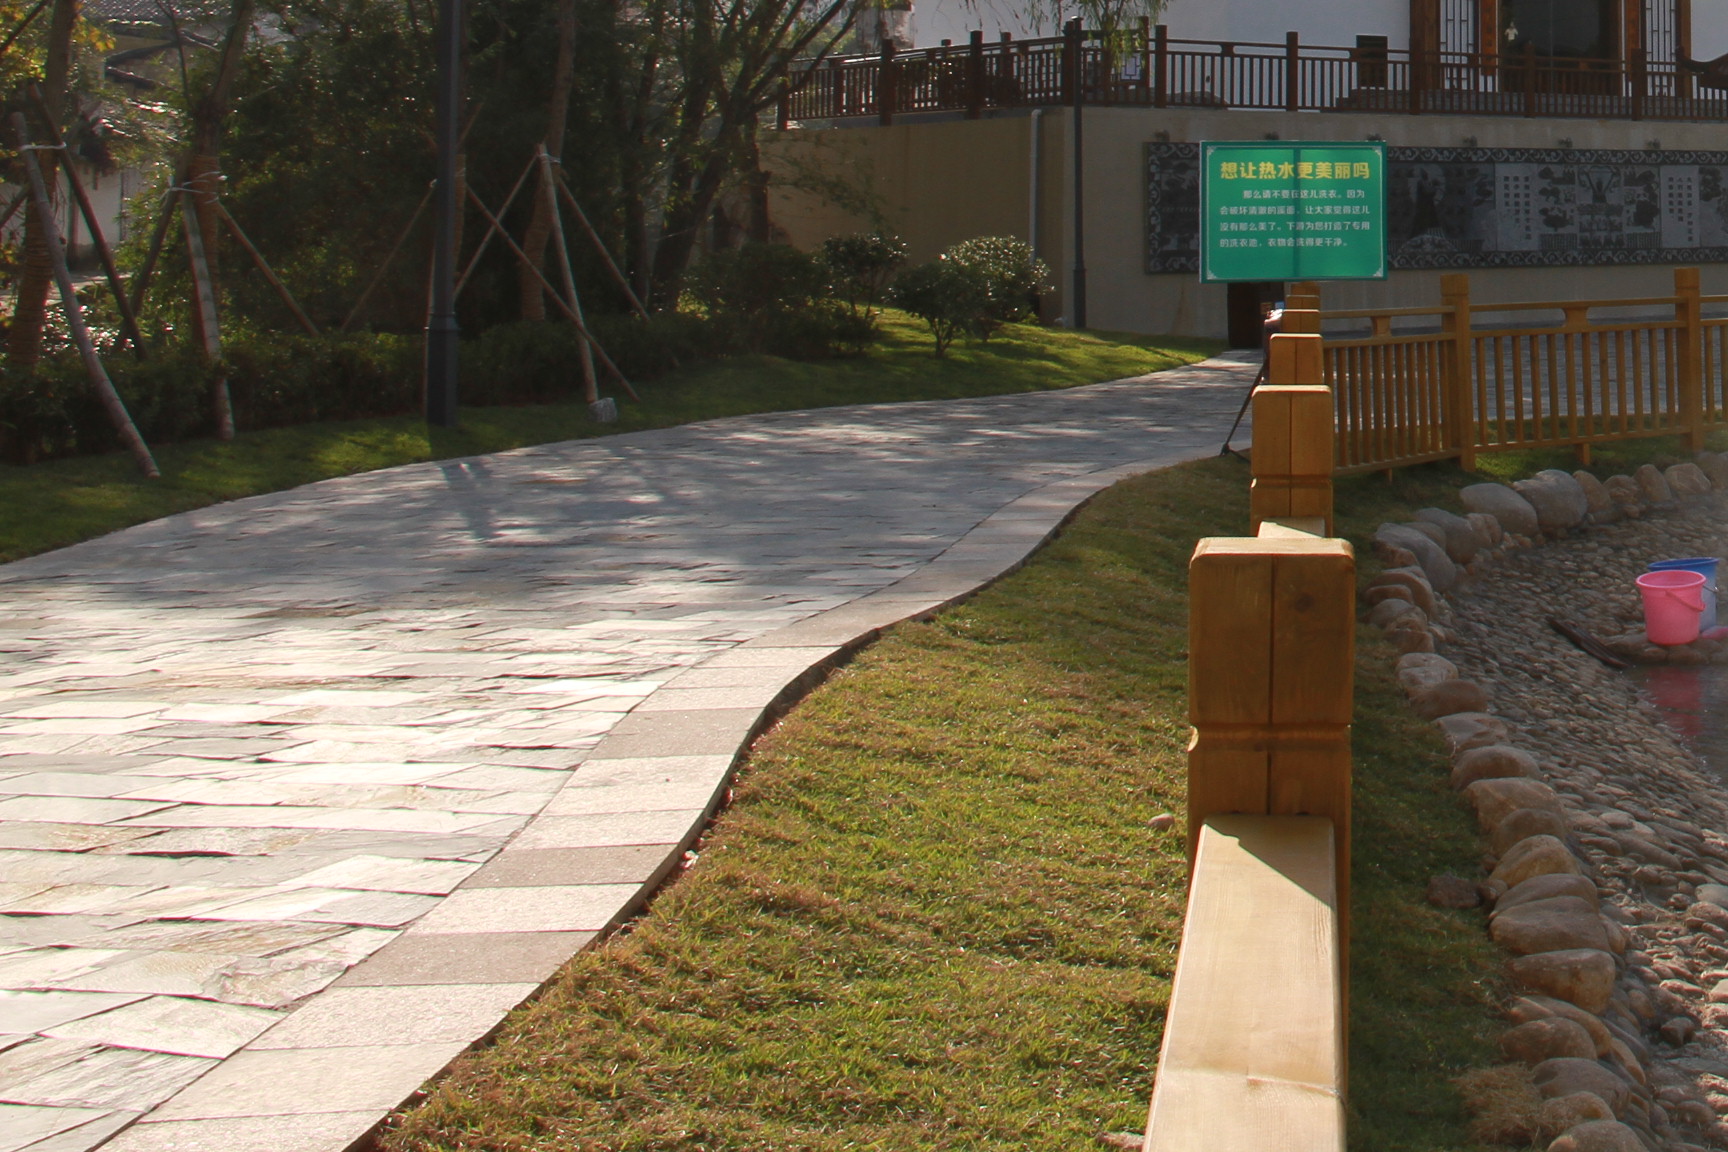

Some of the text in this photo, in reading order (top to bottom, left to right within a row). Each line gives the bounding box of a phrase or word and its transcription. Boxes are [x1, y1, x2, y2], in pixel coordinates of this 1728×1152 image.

[1220, 161, 1370, 180] 想让热水更美丽吗
[1243, 189, 1365, 199] 那么请不要在这儿洗衣。因为
